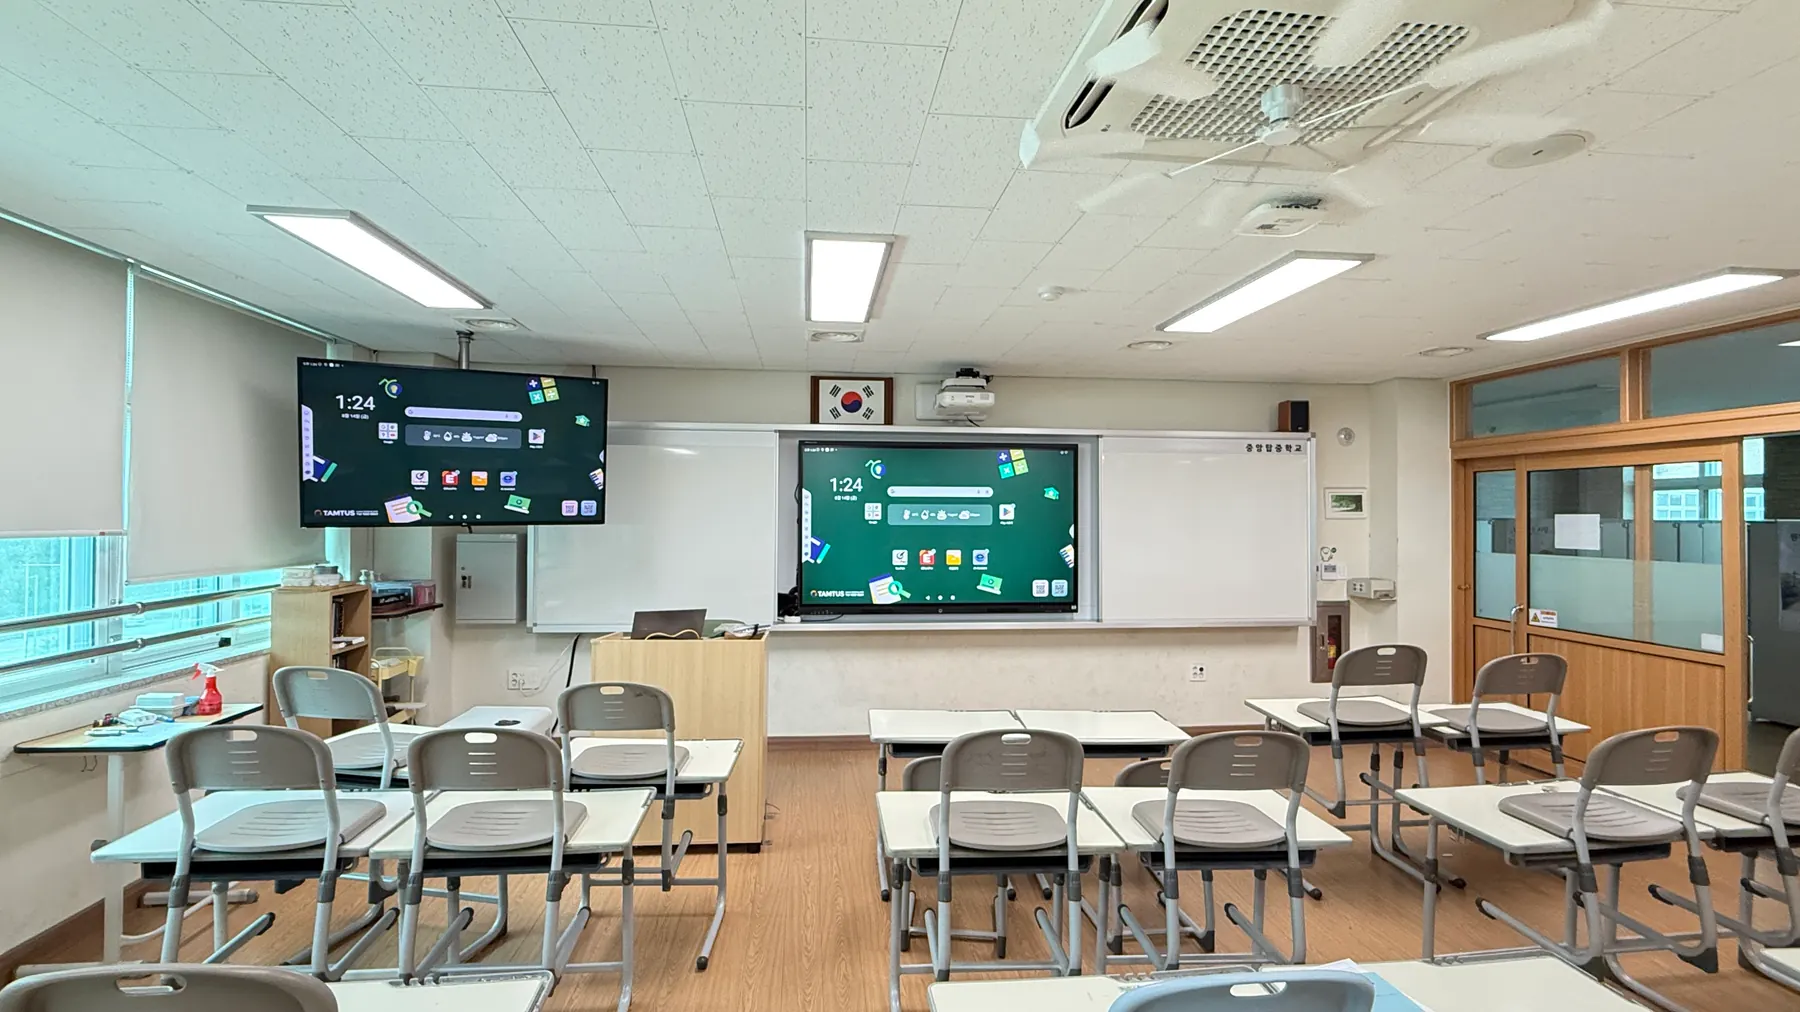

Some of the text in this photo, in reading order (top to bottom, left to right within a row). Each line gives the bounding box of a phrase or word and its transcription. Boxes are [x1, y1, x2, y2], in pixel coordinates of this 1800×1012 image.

[335, 394, 376, 411] 1:24
[1245, 443, 1302, 453] 중앙탑중학교
[829, 477, 863, 492] 1:24
